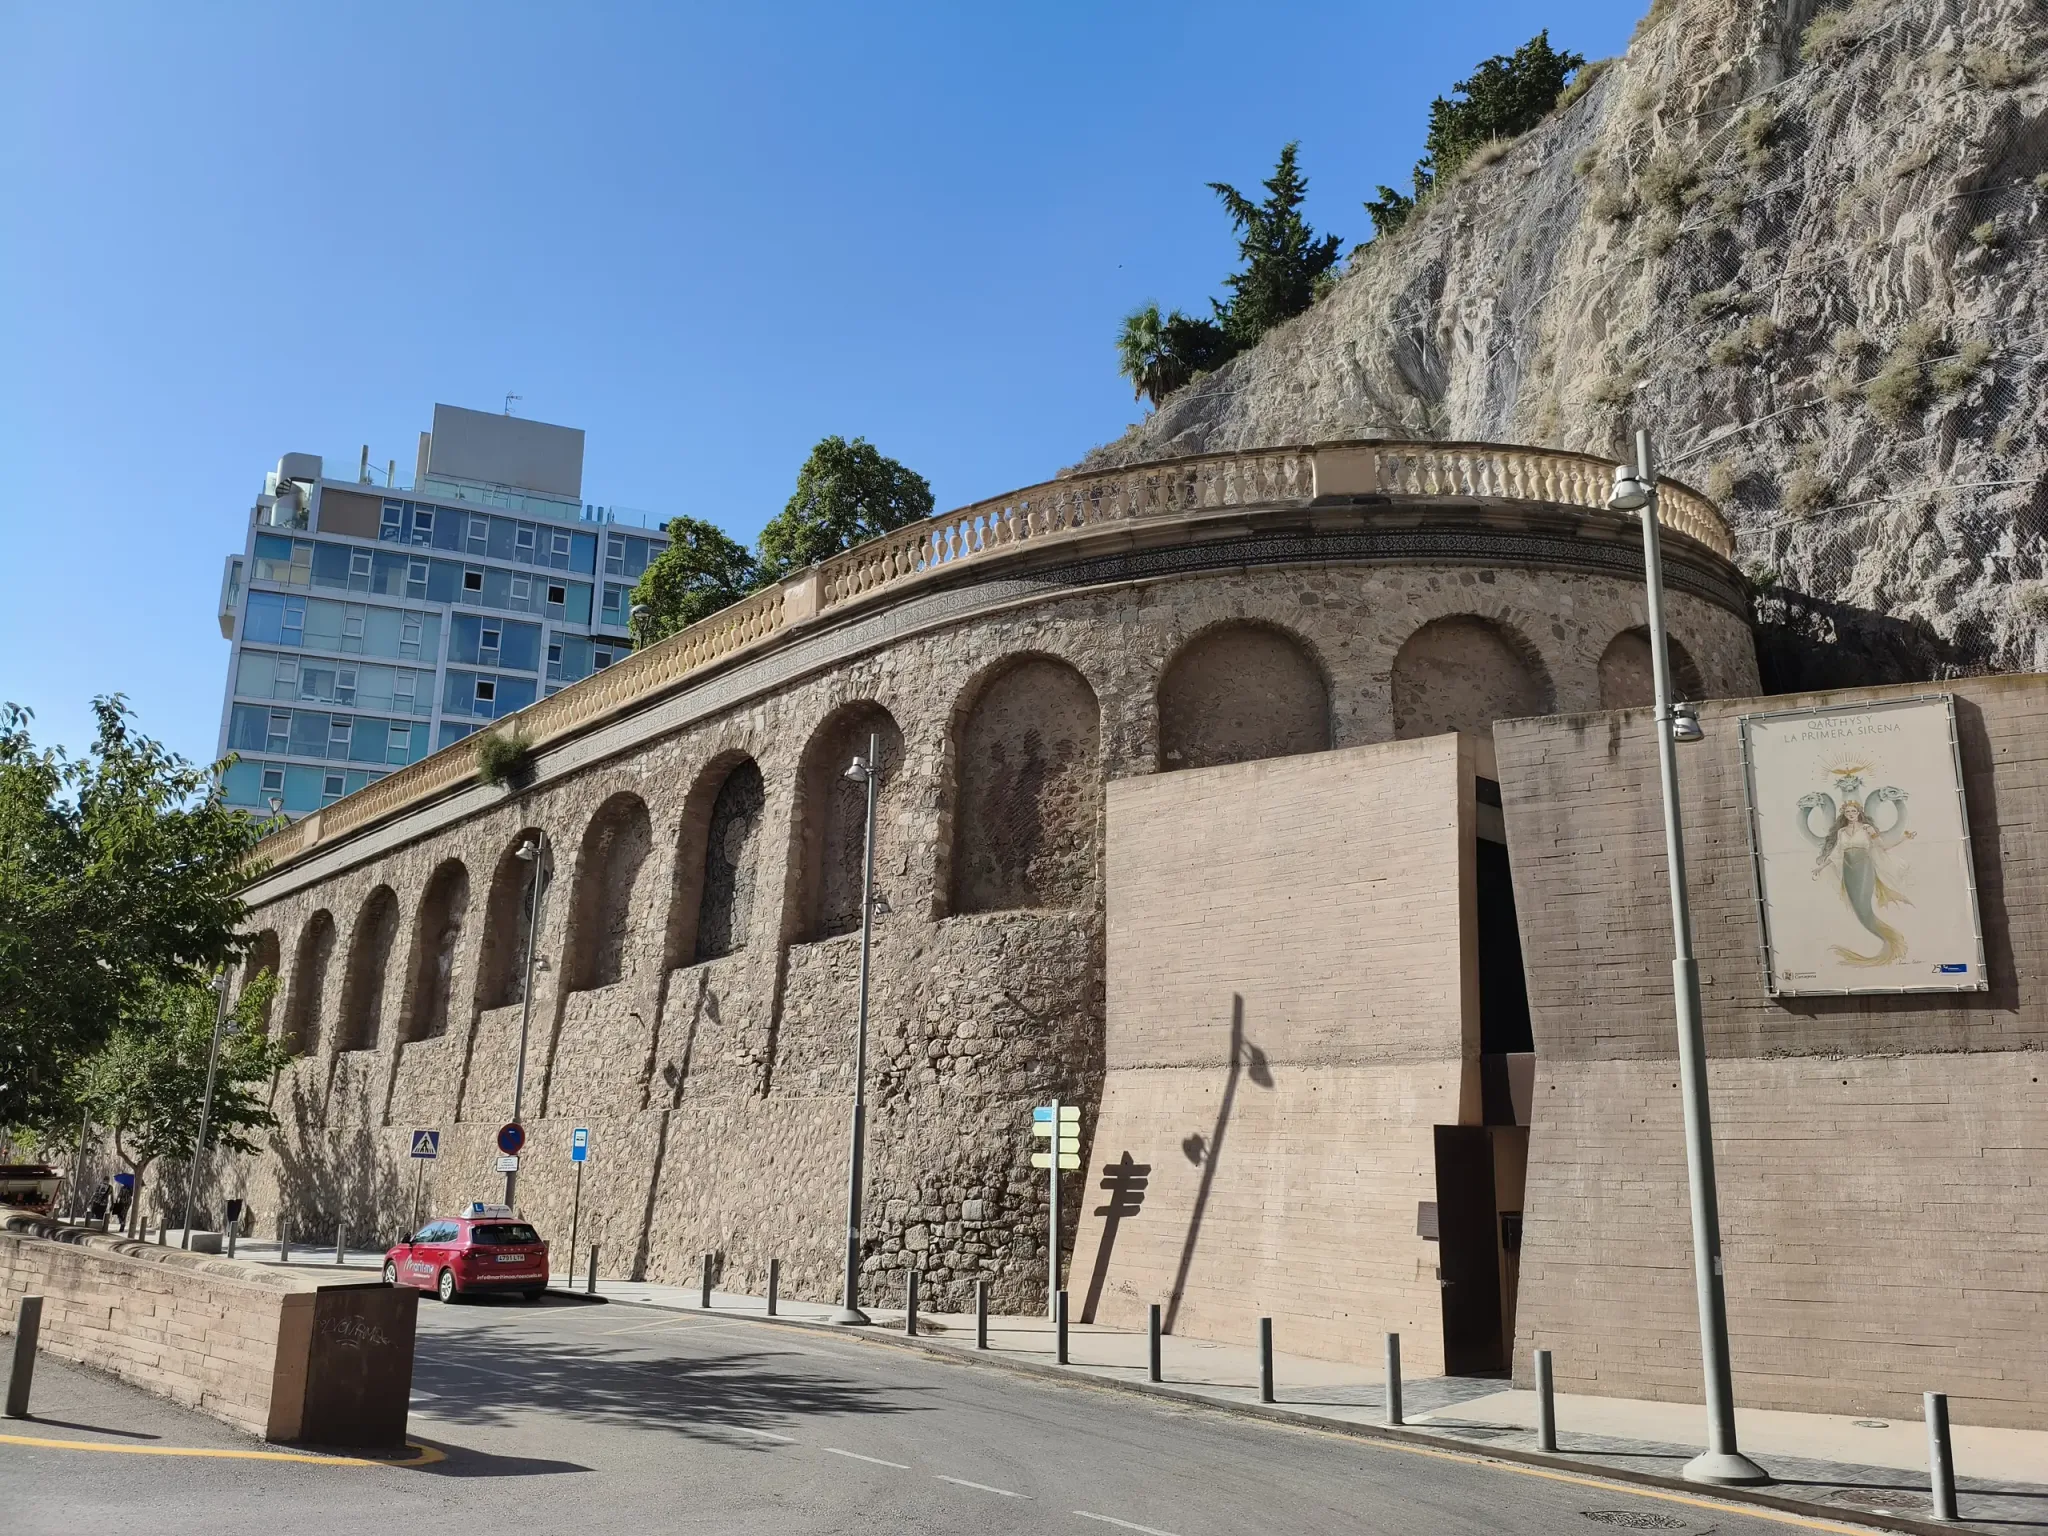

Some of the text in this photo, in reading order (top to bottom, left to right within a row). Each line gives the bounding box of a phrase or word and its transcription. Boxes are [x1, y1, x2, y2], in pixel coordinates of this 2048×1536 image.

[1807, 714, 1873, 731] QARTHYS Y
[1783, 723, 1901, 744] LA PRIMERA SIRENA
